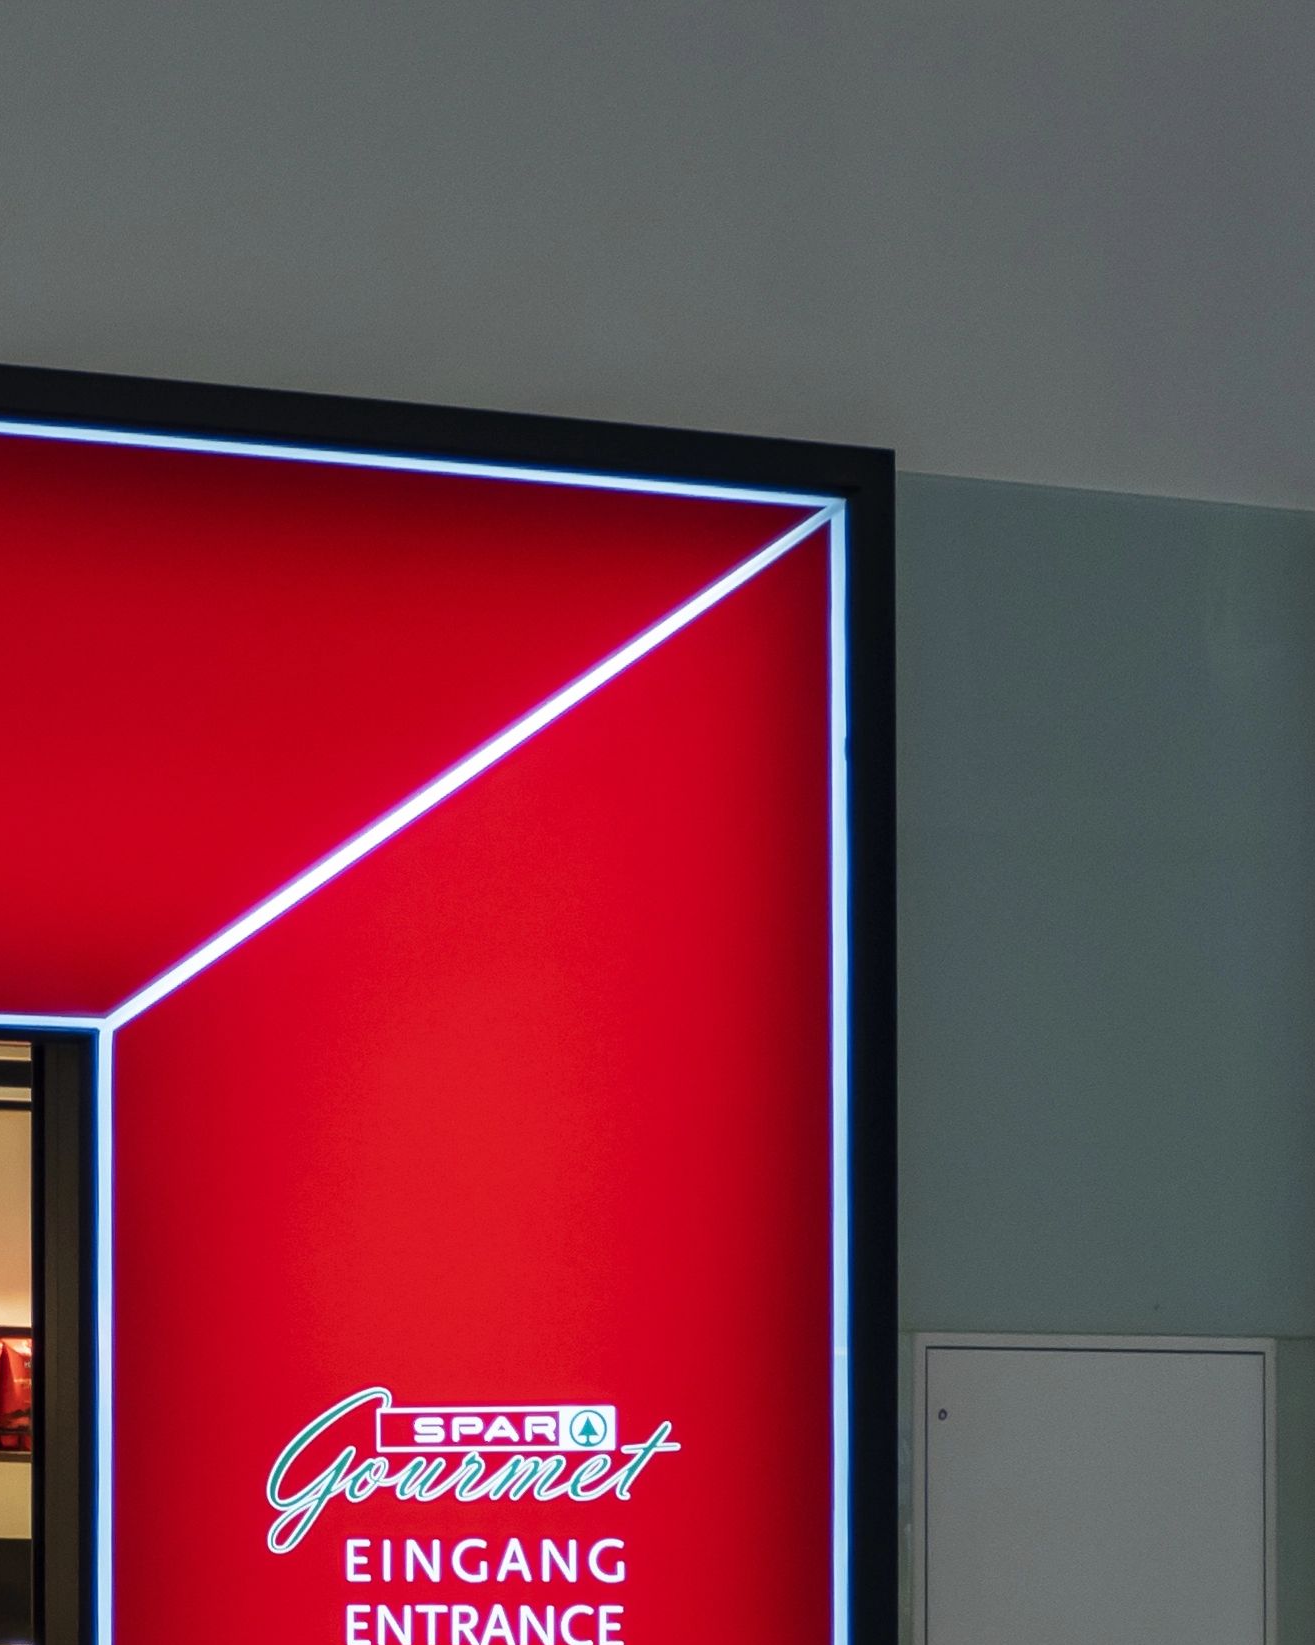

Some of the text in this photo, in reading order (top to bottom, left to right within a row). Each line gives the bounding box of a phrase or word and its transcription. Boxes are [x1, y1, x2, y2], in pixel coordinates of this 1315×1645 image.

[413, 1416, 557, 1443] SPAR
[267, 1386, 681, 1554] Gourmet
[346, 1539, 626, 1583] EINGANG
